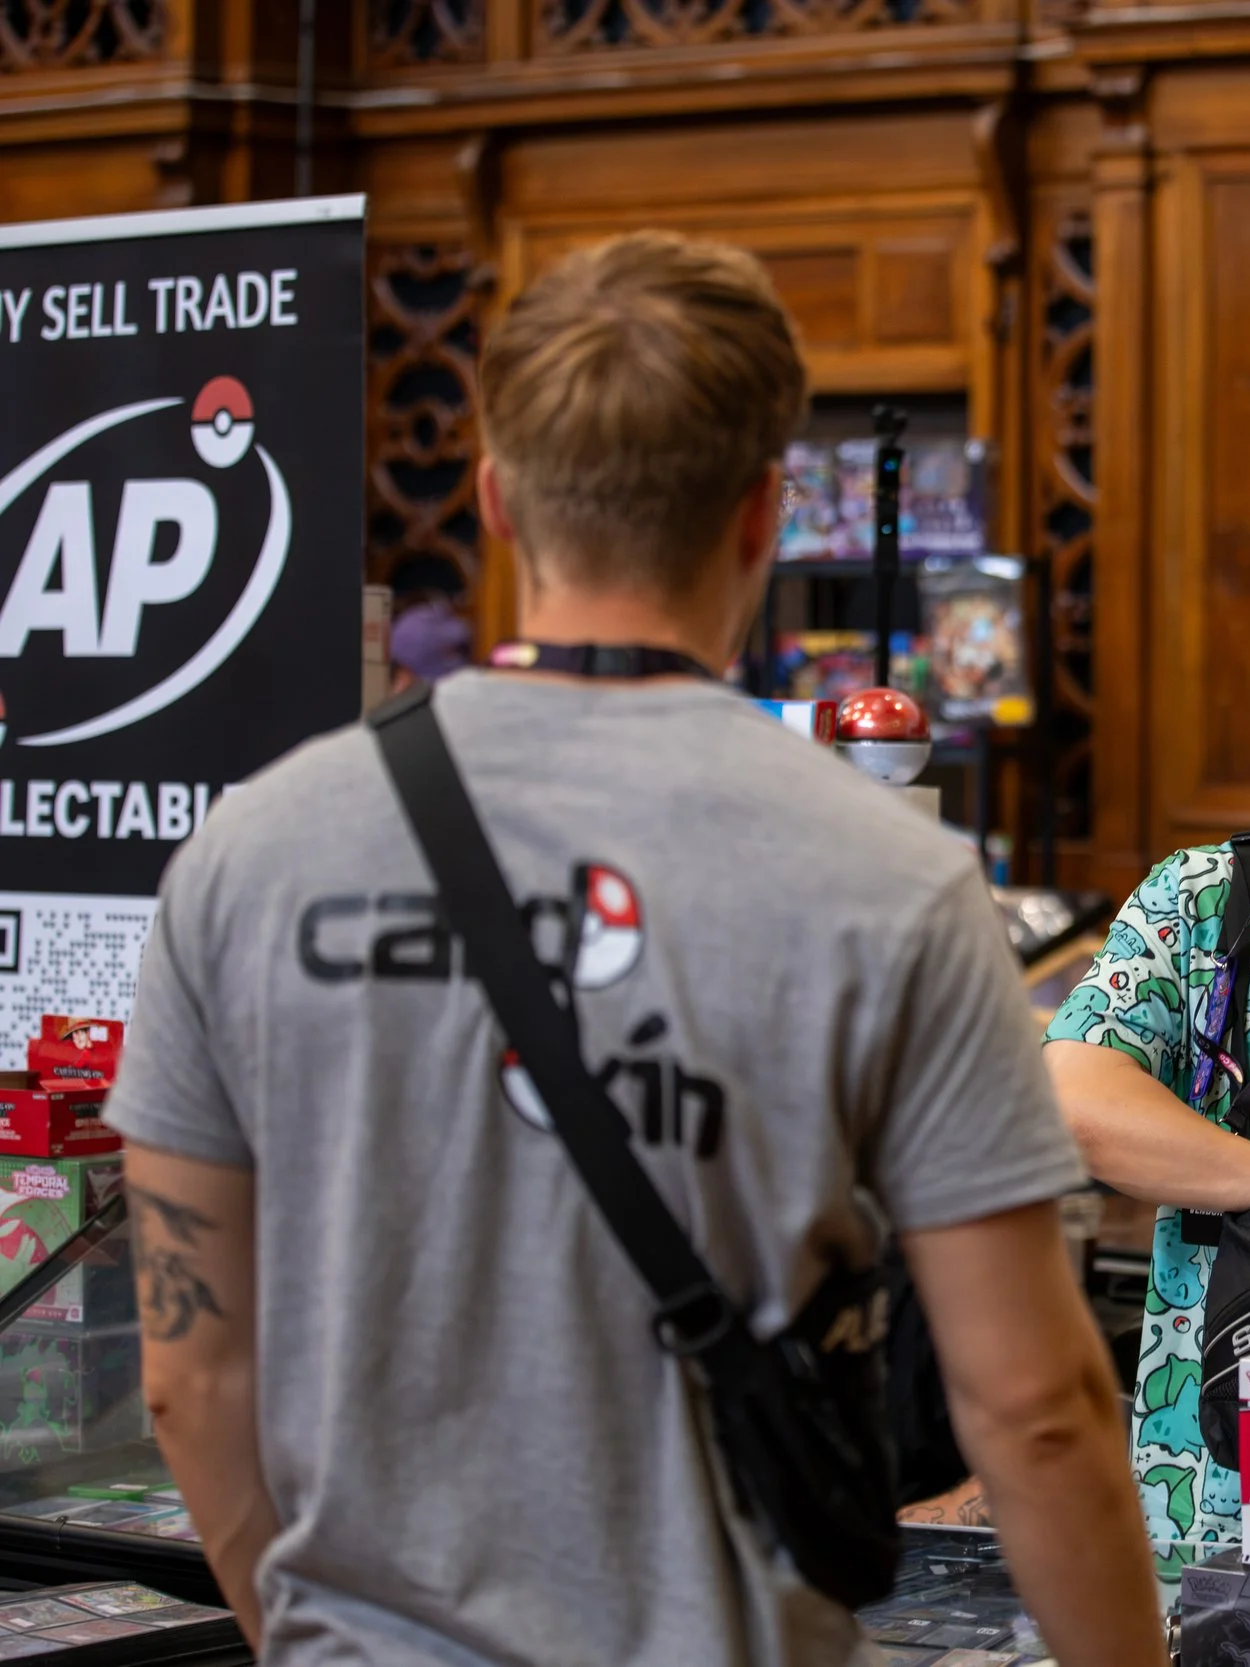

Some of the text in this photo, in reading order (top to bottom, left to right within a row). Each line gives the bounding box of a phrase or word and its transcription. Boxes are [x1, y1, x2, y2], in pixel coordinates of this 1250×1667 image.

[0, 268, 298, 343] Y SELL TRADE
[0, 478, 219, 658] AP
